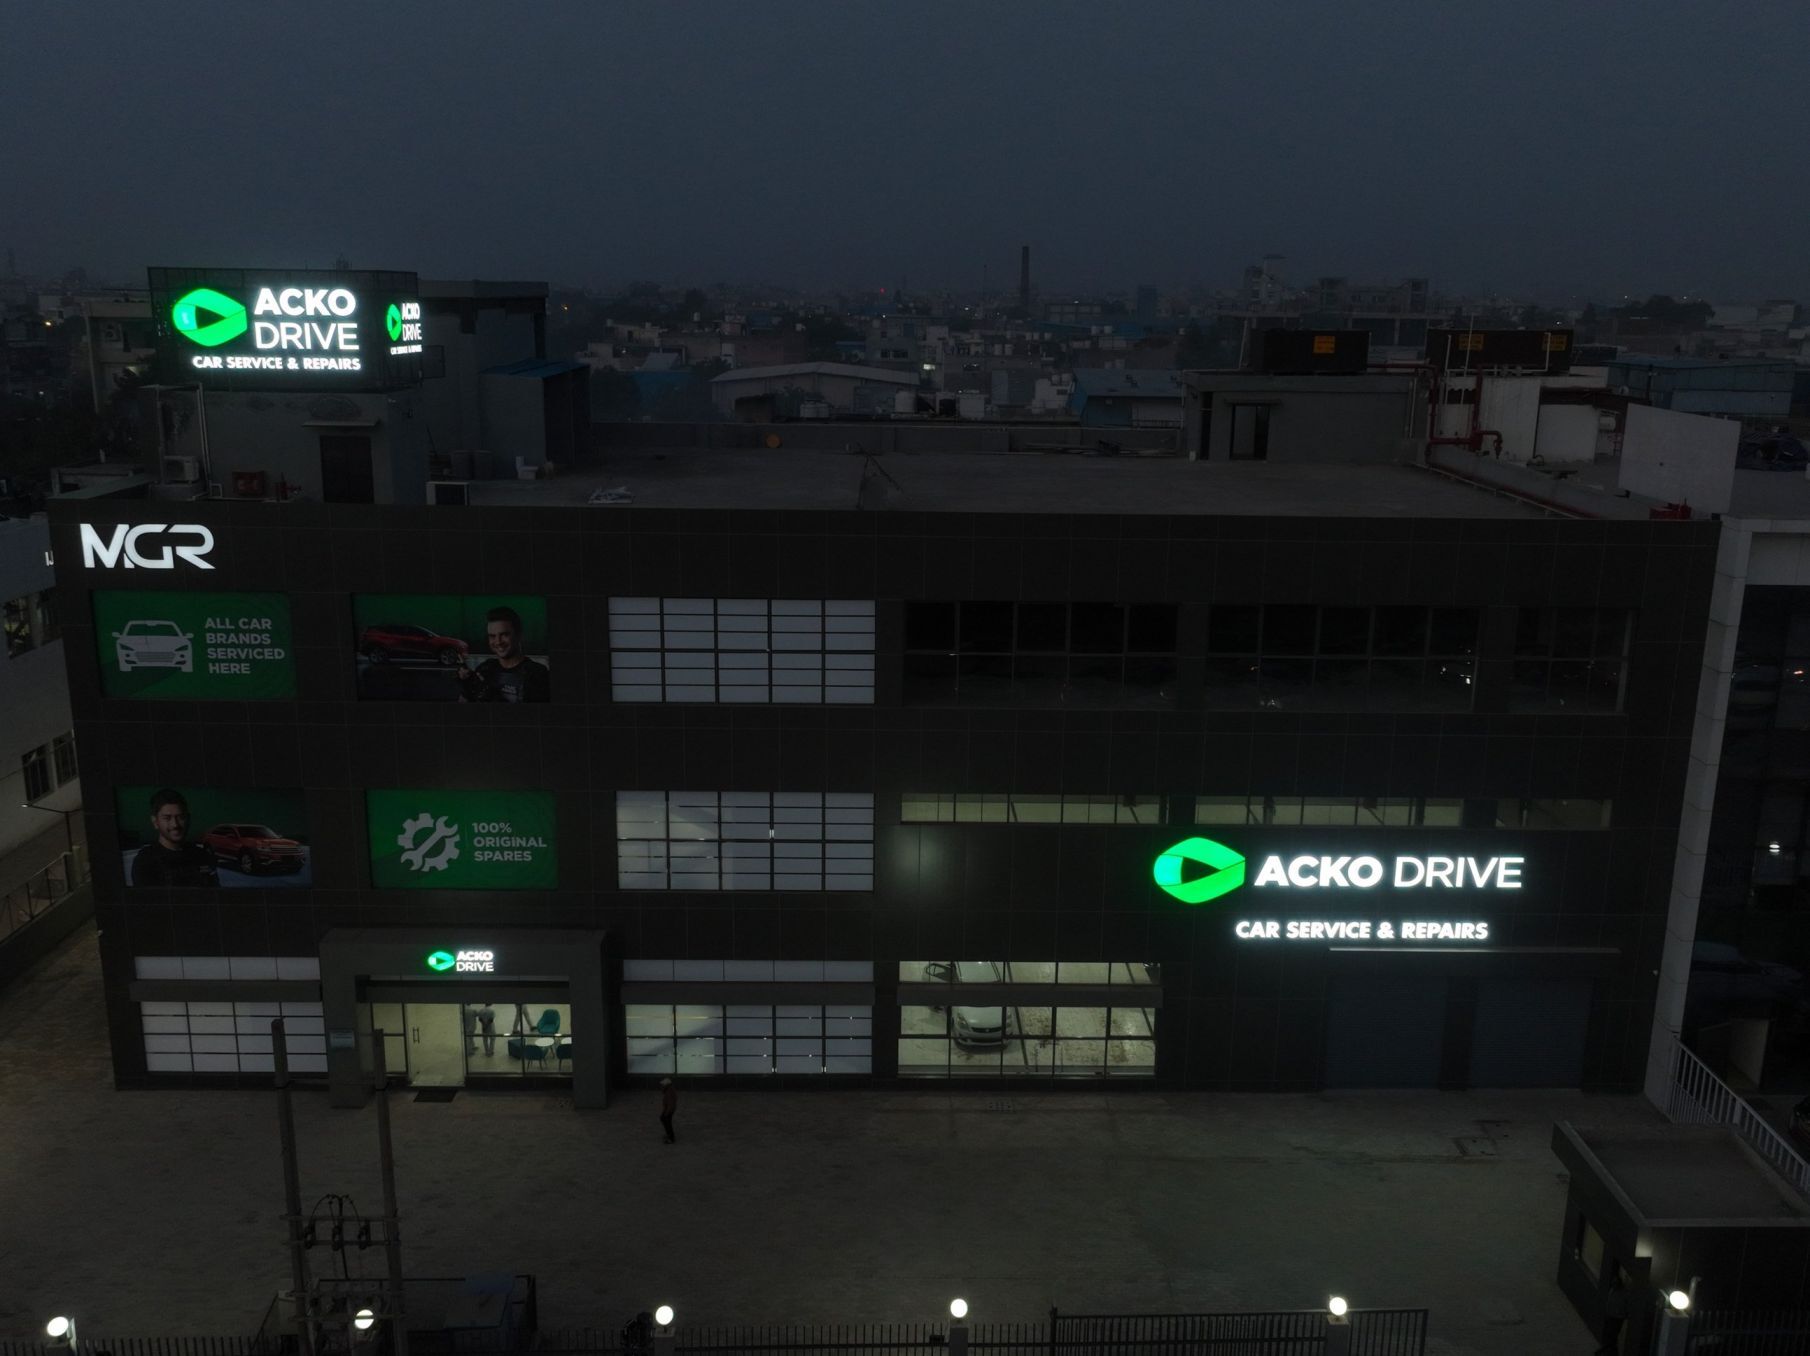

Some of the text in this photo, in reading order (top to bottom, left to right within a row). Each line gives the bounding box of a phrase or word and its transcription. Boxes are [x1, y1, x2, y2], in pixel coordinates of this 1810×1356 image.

[253, 287, 357, 317] ACKO
[254, 321, 360, 351] DRIVE
[402, 323, 423, 341] DRIVE
[192, 355, 362, 371] CAR SERVICE & REPAIRS
[79, 523, 216, 569] MGR
[204, 617, 272, 630] ALL CAR
[205, 632, 271, 645] BRANDS
[207, 647, 285, 660] SERVICED
[208, 662, 251, 675] HERE
[471, 822, 512, 834] 100%
[473, 836, 547, 848] ORIGINAL
[474, 850, 532, 862] SPARES
[1253, 855, 1525, 889] ACKO DRIVE
[1235, 920, 1489, 940] CAR SERVICE & REPAIRS
[456, 950, 494, 961] ACKO
[456, 961, 495, 972] DRIVE
